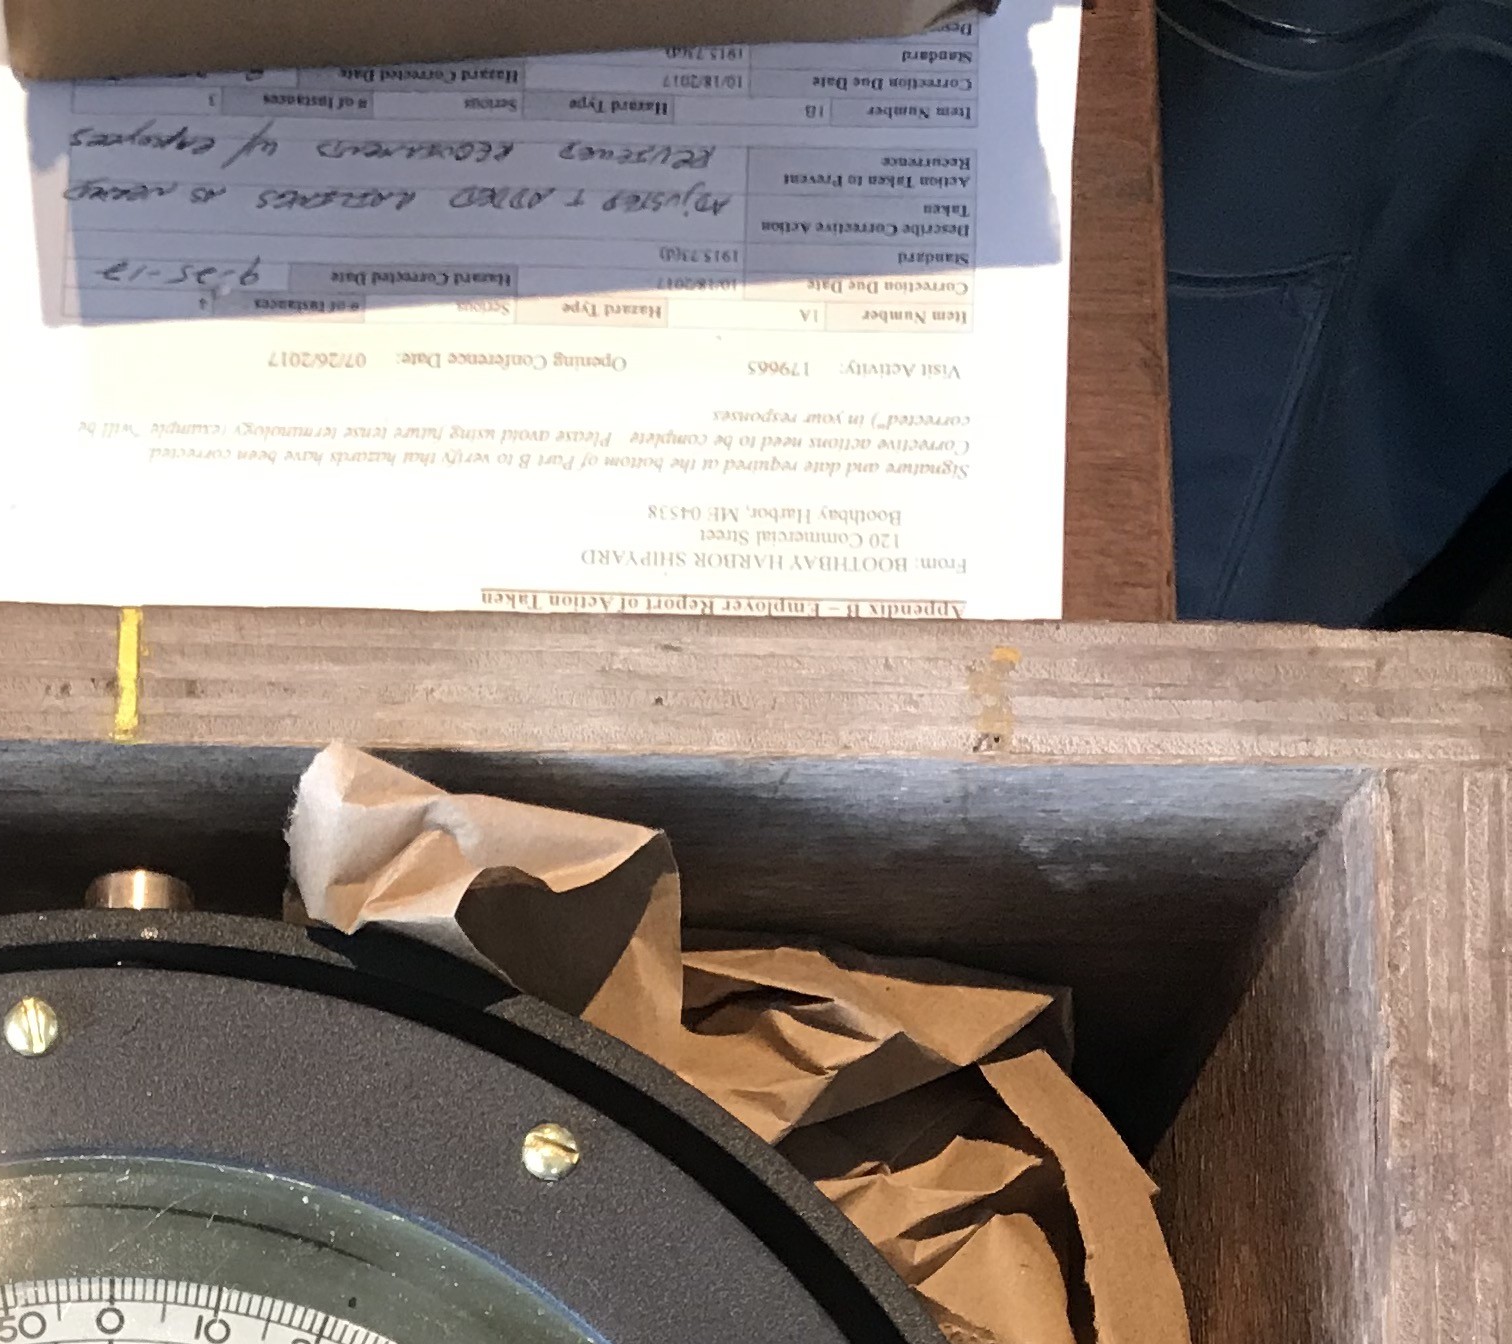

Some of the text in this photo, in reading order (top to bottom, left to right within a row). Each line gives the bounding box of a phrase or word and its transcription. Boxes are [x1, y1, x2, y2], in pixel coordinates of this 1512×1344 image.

[901, 49, 971, 62] Standard
[339, 67, 517, 82] Hazard Corrected Date
[812, 75, 971, 90] Correction Due Date
[262, 93, 352, 109] of Instances
[463, 95, 516, 112] Serious
[567, 97, 667, 115] Hazard Type
[865, 104, 970, 119] Item Number
[880, 154, 969, 169] Recurrence
[782, 172, 968, 187] Action Taken to Prevent
[923, 202, 968, 217] Taken
[760, 219, 968, 236] Describe Corrective Action
[896, 250, 968, 265] Standard
[329, 270, 510, 286] Hazard Corrected Date
[806, 279, 967, 294] Correction Due Date
[561, 299, 660, 318] Hazard Type
[798, 307, 818, 322] 1A
[860, 308, 967, 322] Item Number
[266, 350, 626, 370] Opening Conference Date: 07/26/2017
[747, 358, 960, 379] Visit Activity: 179665
[801, 409, 864, 428] in your
[343, 425, 386, 440] tense
[393, 425, 443, 441] future
[449, 423, 494, 442] using
[501, 428, 548, 445] avoid
[556, 429, 611, 448] Please
[712, 434, 732, 450] be
[738, 434, 754, 448] to
[761, 435, 801, 450] need
[808, 436, 870, 452] actions
[876, 436, 968, 455] Corrective
[237, 447, 968, 478] Signature and date required at the bottom Part B to verify that hazards have been
[647, 503, 901, 525] Boothbay Harbor, ME 04538
[698, 528, 899, 548] 120 Commercial Street
[580, 548, 966, 572] From: BOOTHBAY HARBOR SHIPYARD
[481, 592, 540, 609] Taken
[547, 594, 613, 610] Action
[618, 596, 638, 612] of
[644, 595, 714, 613] Report
[96, 1307, 124, 1335] 0
[194, 1314, 231, 1344] 10
